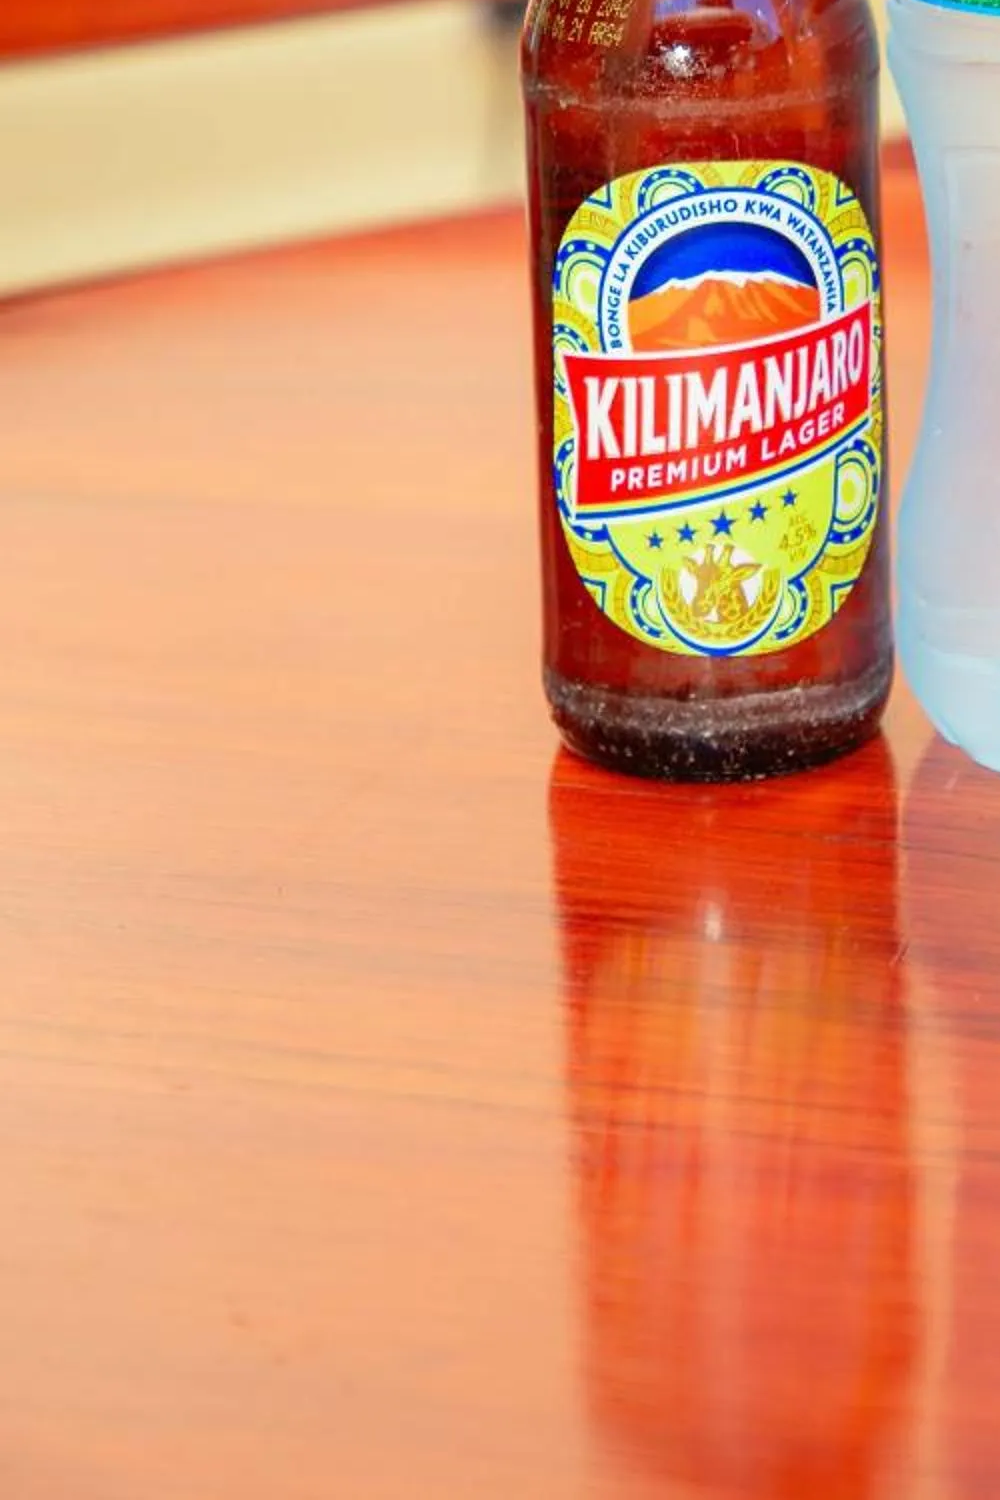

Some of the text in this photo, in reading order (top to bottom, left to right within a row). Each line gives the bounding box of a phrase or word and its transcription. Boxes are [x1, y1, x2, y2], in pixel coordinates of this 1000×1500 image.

[607, 198, 837, 350] BONGE LA KIBURUDISHO KWA WATANZANIA
[583, 318, 863, 461] KILIMANJARO
[610, 403, 845, 493] PREMIUM LAGER
